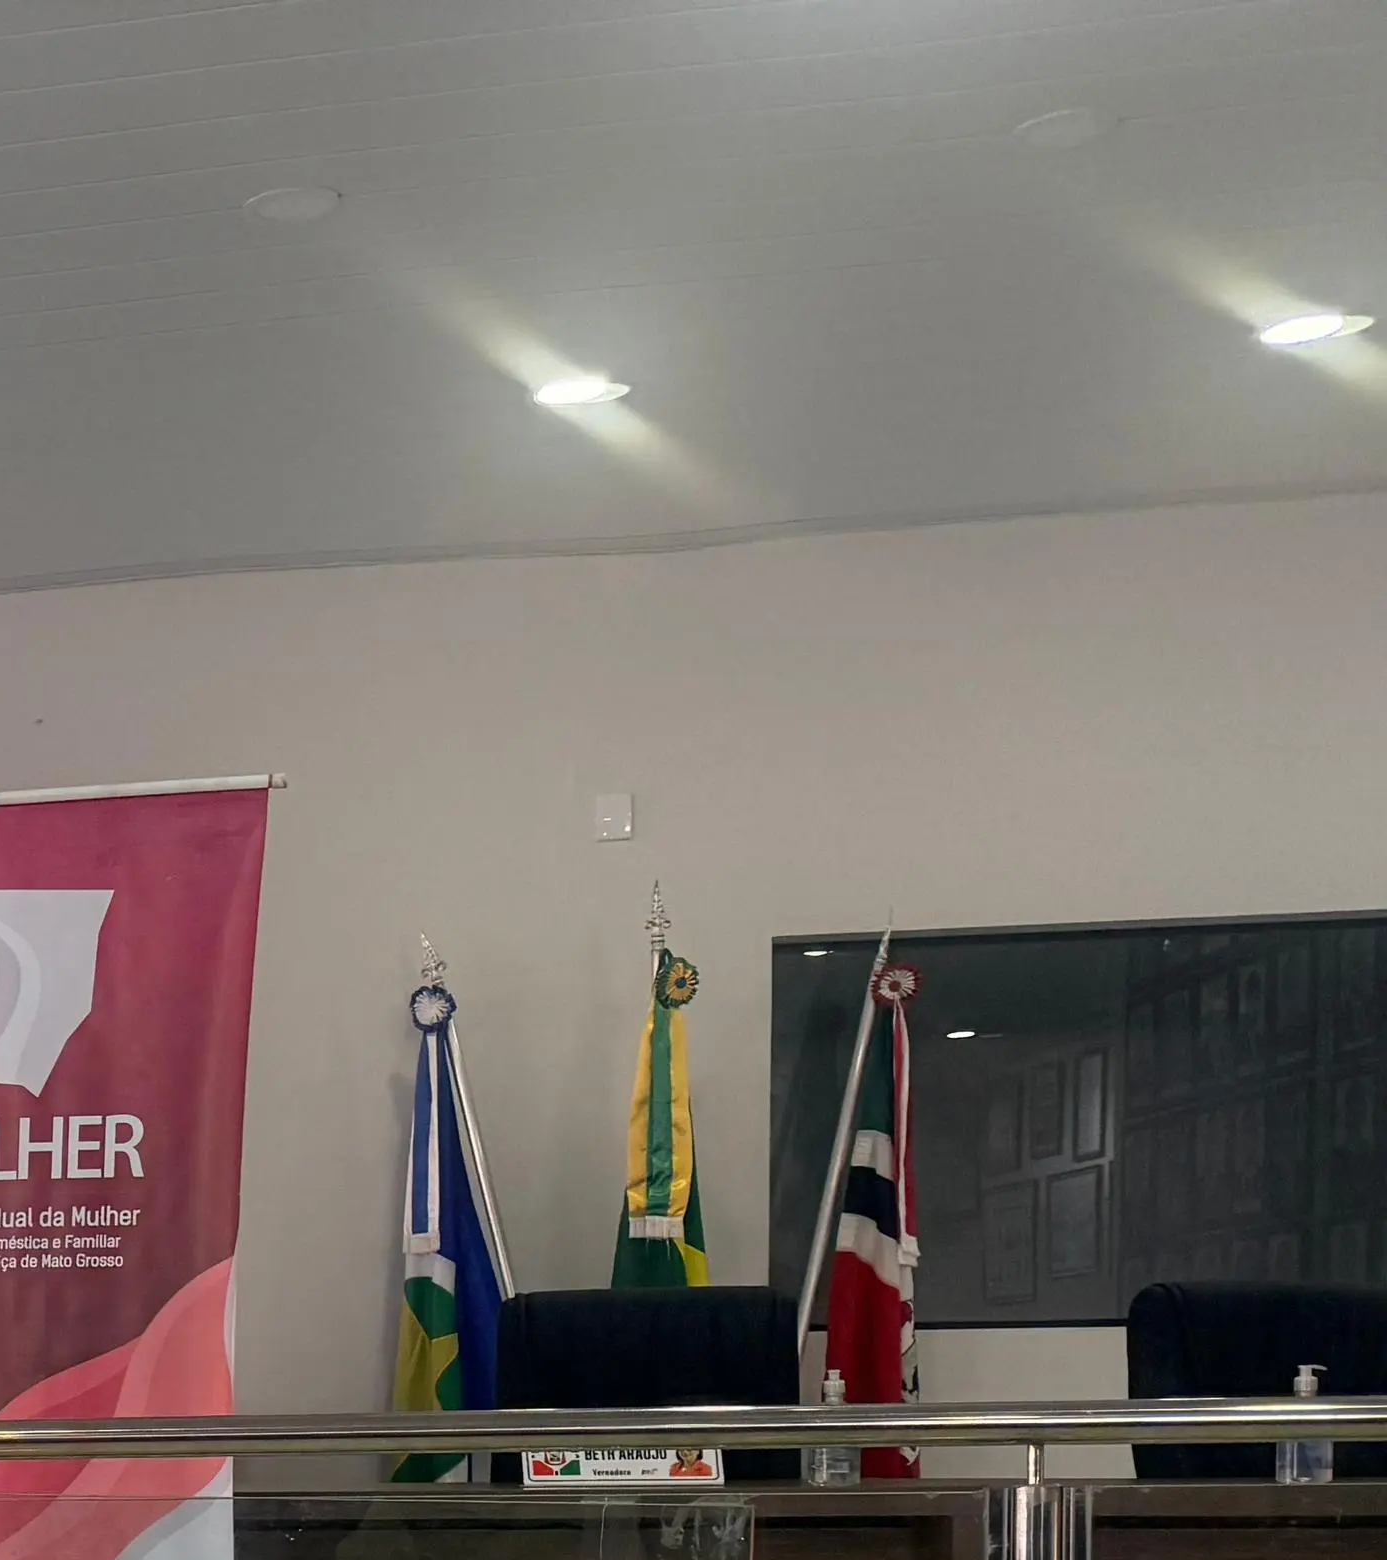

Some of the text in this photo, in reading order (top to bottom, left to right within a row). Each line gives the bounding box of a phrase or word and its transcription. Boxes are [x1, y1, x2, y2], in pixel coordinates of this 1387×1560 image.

[39, 1206, 65, 1228] da
[71, 1205, 141, 1227] Mulher
[52, 1239, 61, 1249] e
[65, 1234, 121, 1249] Familiar
[20, 1254, 38, 1268] de
[41, 1253, 72, 1268] Mato
[76, 1253, 124, 1267] Grosso
